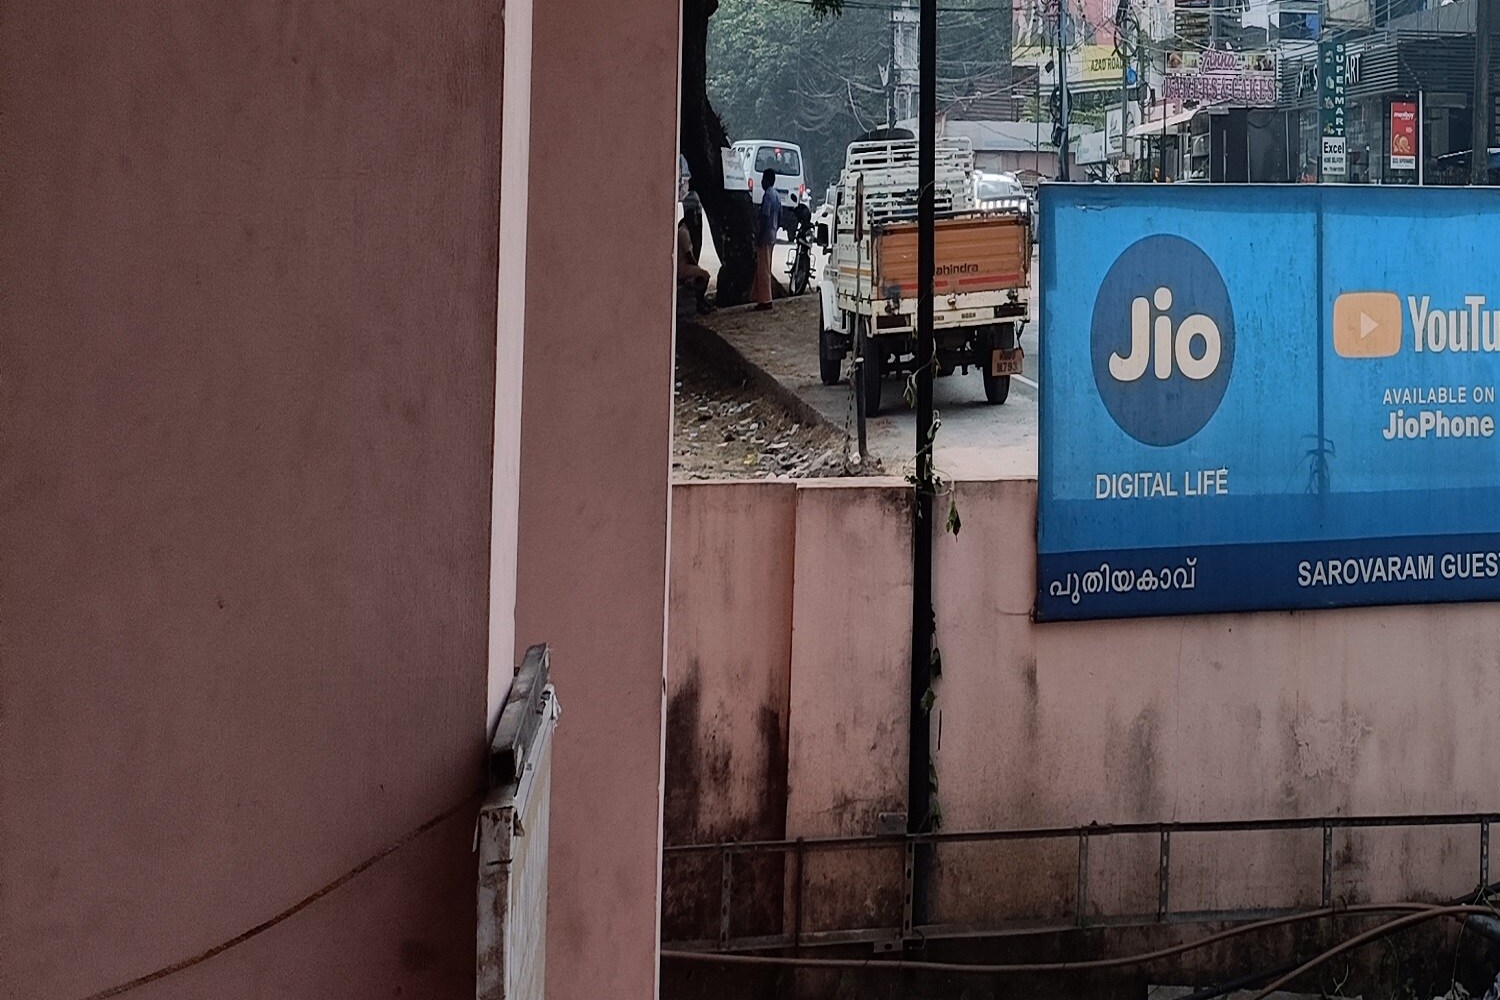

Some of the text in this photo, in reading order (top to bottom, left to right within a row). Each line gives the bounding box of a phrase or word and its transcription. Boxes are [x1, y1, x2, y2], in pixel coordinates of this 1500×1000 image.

[1334, 44, 1345, 136] SUPERMART
[1323, 141, 1345, 154] Excel
[936, 263, 979, 276] ahindra
[1108, 286, 1222, 382] Jio
[1382, 386, 1496, 405] AVAILABLE ON
[1382, 410, 1495, 440] JioPhone
[1095, 468, 1229, 500] DIGITAL LIFE
[1048, 556, 1198, 604] പുതിയകാവ്
[1297, 555, 1436, 588] SAROVARAM
